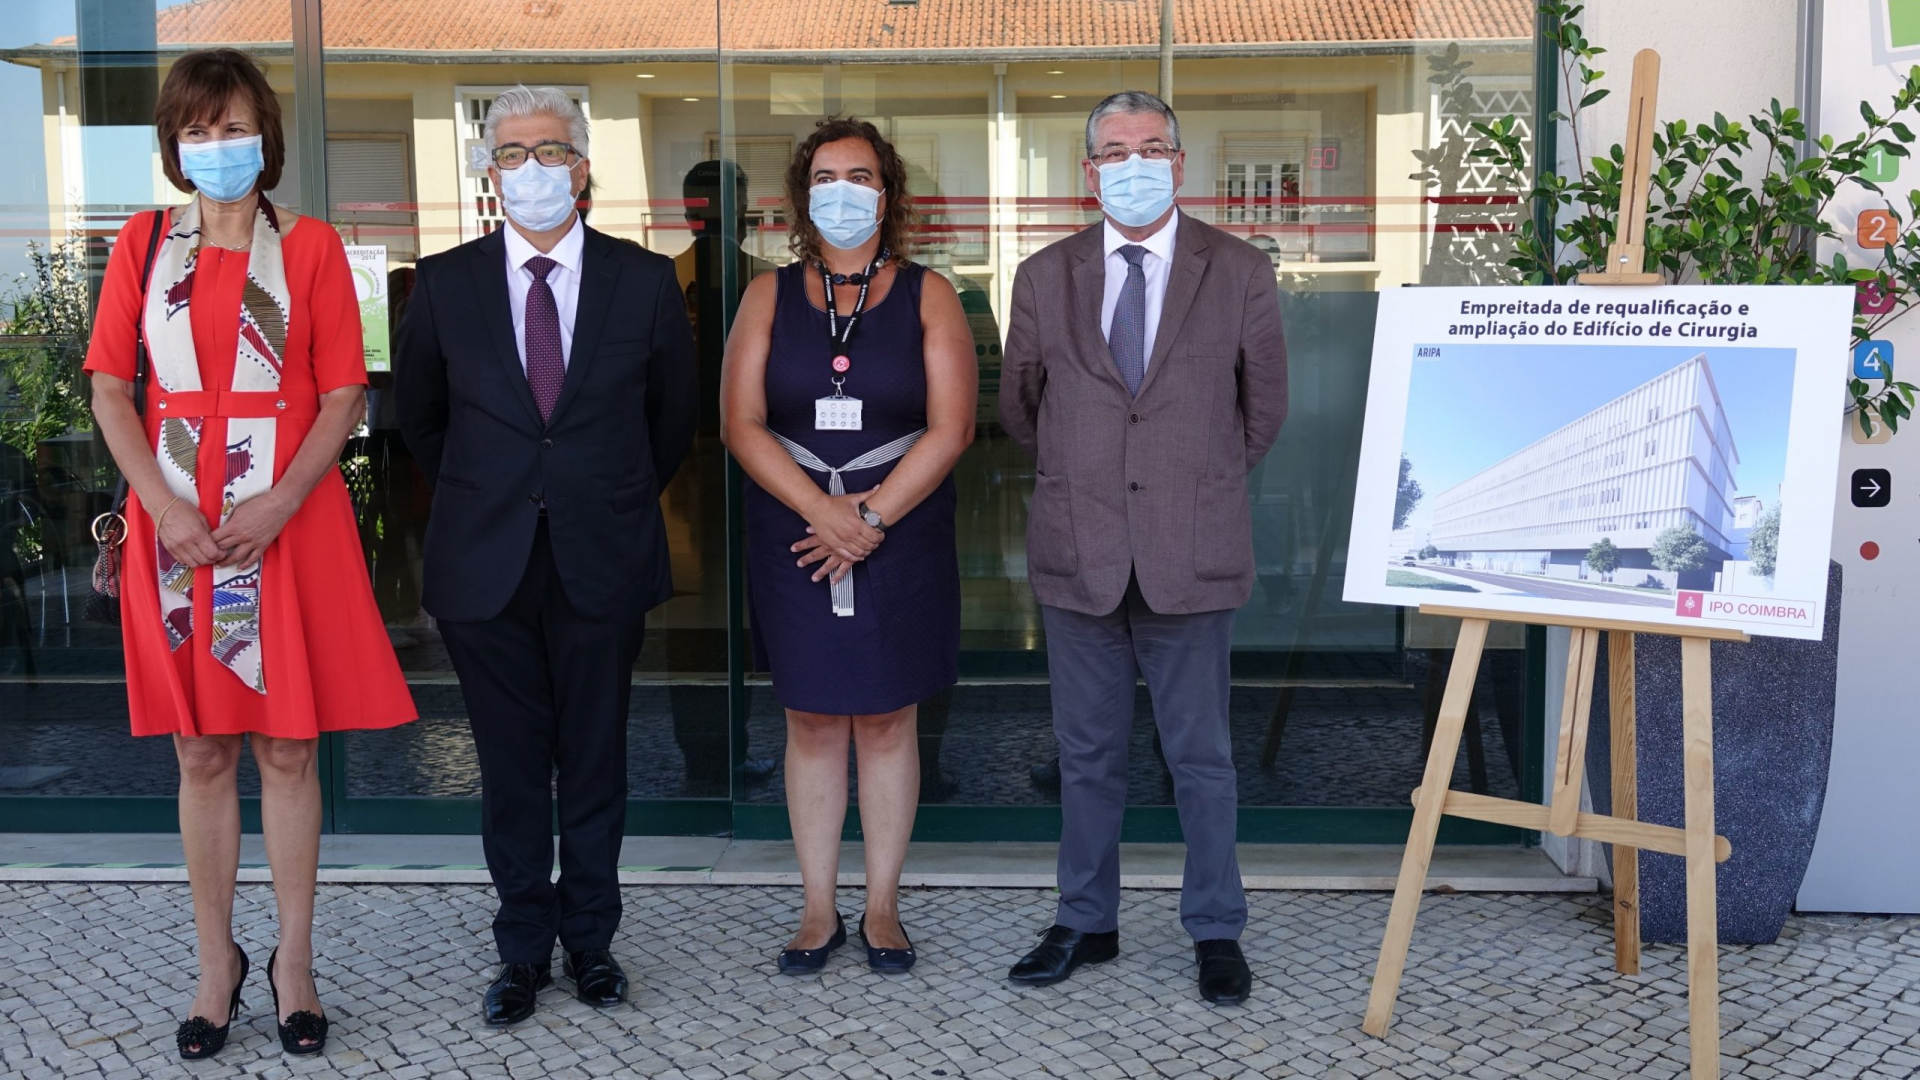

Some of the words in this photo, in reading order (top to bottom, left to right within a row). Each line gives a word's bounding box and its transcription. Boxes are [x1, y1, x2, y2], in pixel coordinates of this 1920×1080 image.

[1231, 92, 1278, 103] ATENDIMENTO
[1310, 147, 1337, 168] 60
[1872, 150, 1883, 176] 1
[1869, 216, 1887, 241] 2
[1460, 299, 1562, 318] Empreitada
[1568, 299, 1591, 315] de
[1596, 299, 1732, 319] requalificação
[1738, 303, 1750, 315] e
[1448, 320, 1540, 339] ampliação
[1544, 320, 1568, 336] do
[1573, 320, 1643, 337] Edifício
[1648, 321, 1672, 337] de
[1678, 321, 1758, 342] Cirurgia
[1417, 347, 1441, 358] ARIPA
[1863, 347, 1882, 372] 4
[1709, 601, 1734, 614] IPO
[1738, 603, 1807, 620] COIMBRA
